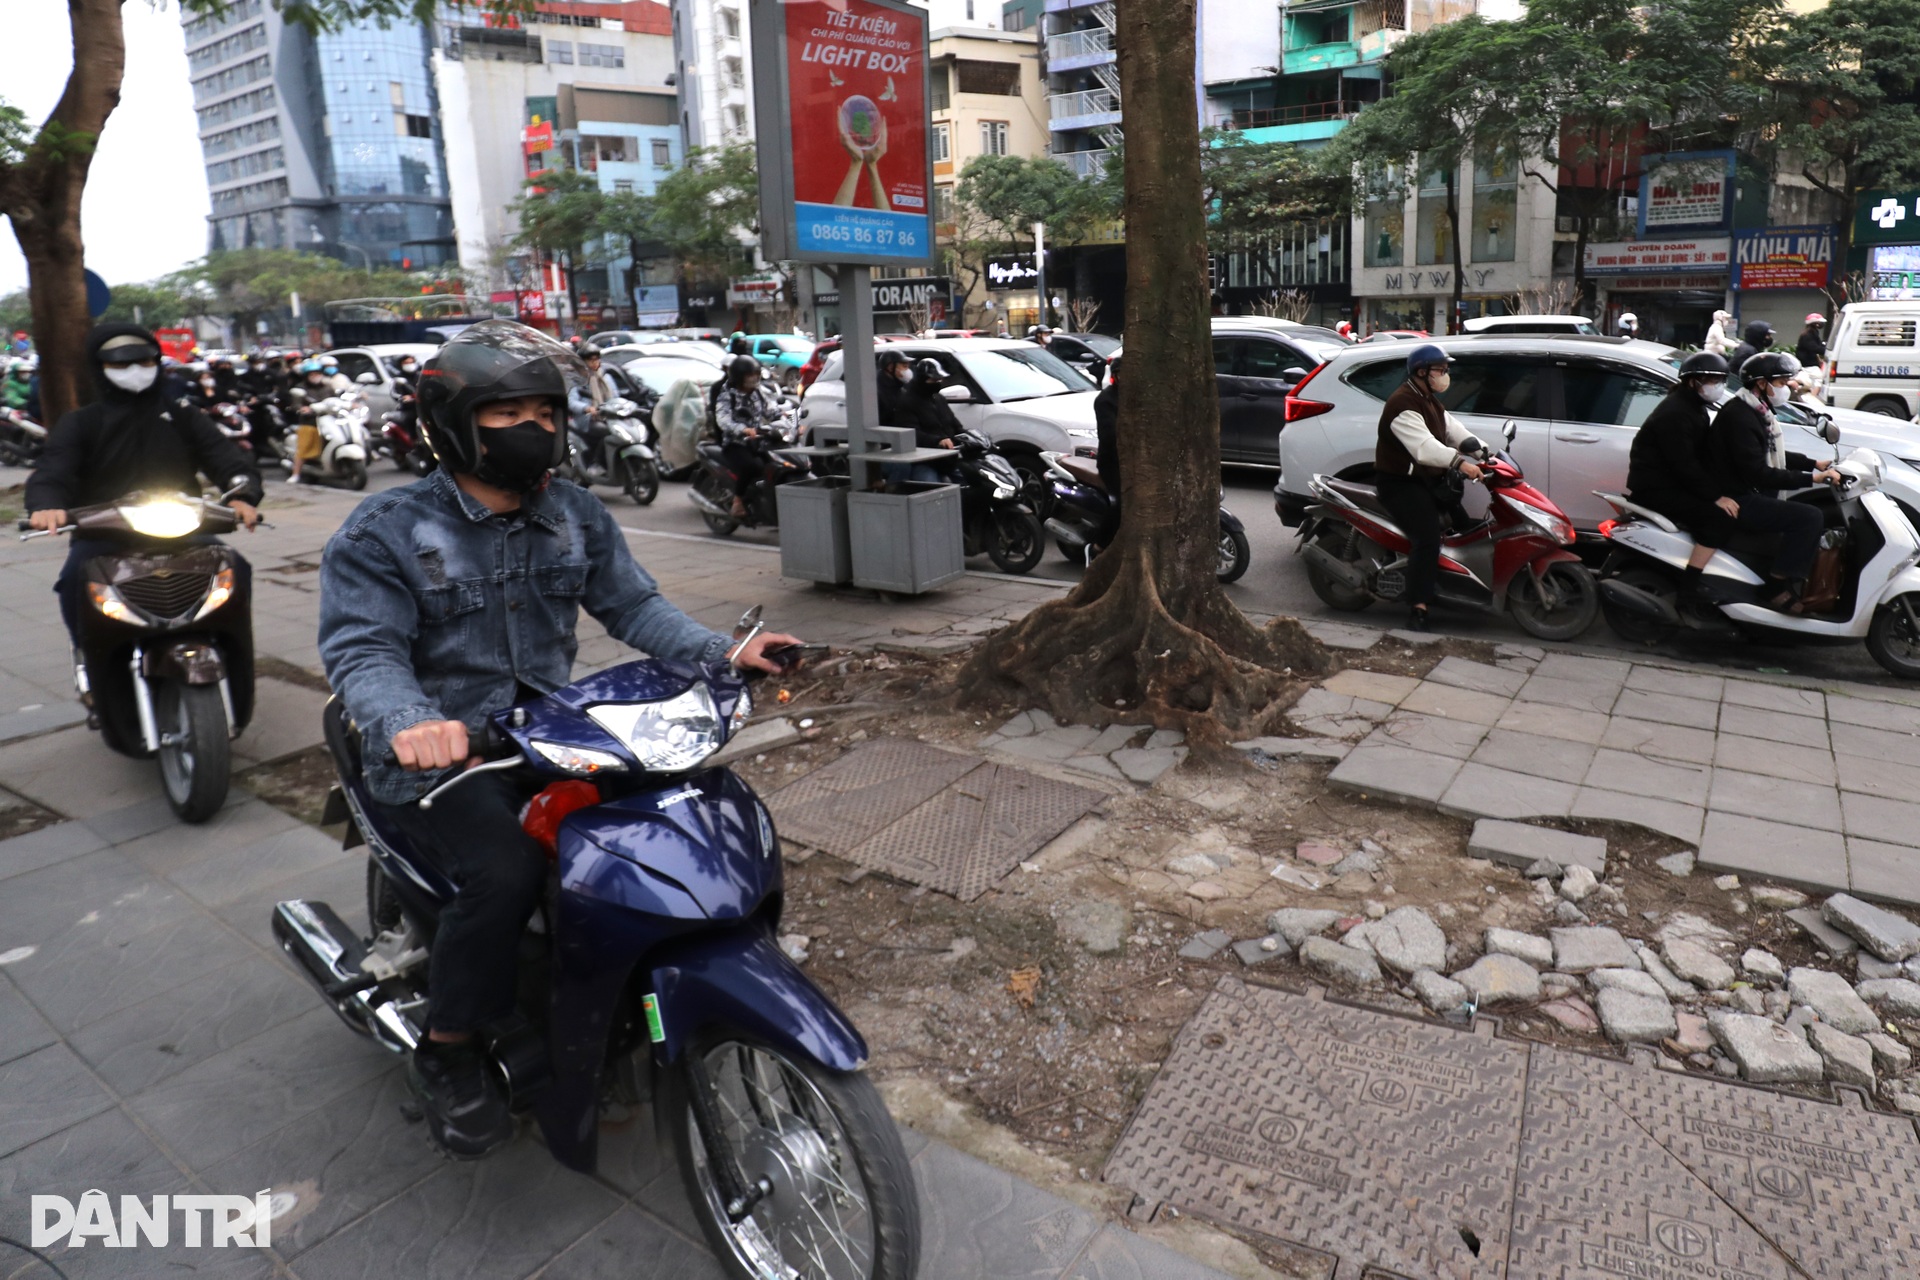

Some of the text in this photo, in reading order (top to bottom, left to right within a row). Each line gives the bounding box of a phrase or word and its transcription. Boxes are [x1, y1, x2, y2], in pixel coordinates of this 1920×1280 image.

[826, 9, 897, 36] TIẾT KIỆM
[811, 27, 828, 38] CHI
[828, 29, 845, 39] PHÍ
[877, 37, 895, 49] CÁO
[801, 42, 911, 74] LIGHT BOX
[812, 223, 850, 241] 0865
[854, 227, 872, 243] 86
[876, 229, 893, 245] 87
[898, 231, 915, 247] 86
[1736, 226, 1838, 263] KÍNH MẮ
[1663, 243, 1696, 251] DOANH
[656, 788, 704, 809] HONDA
[1669, 1256, 1717, 1278] D400
